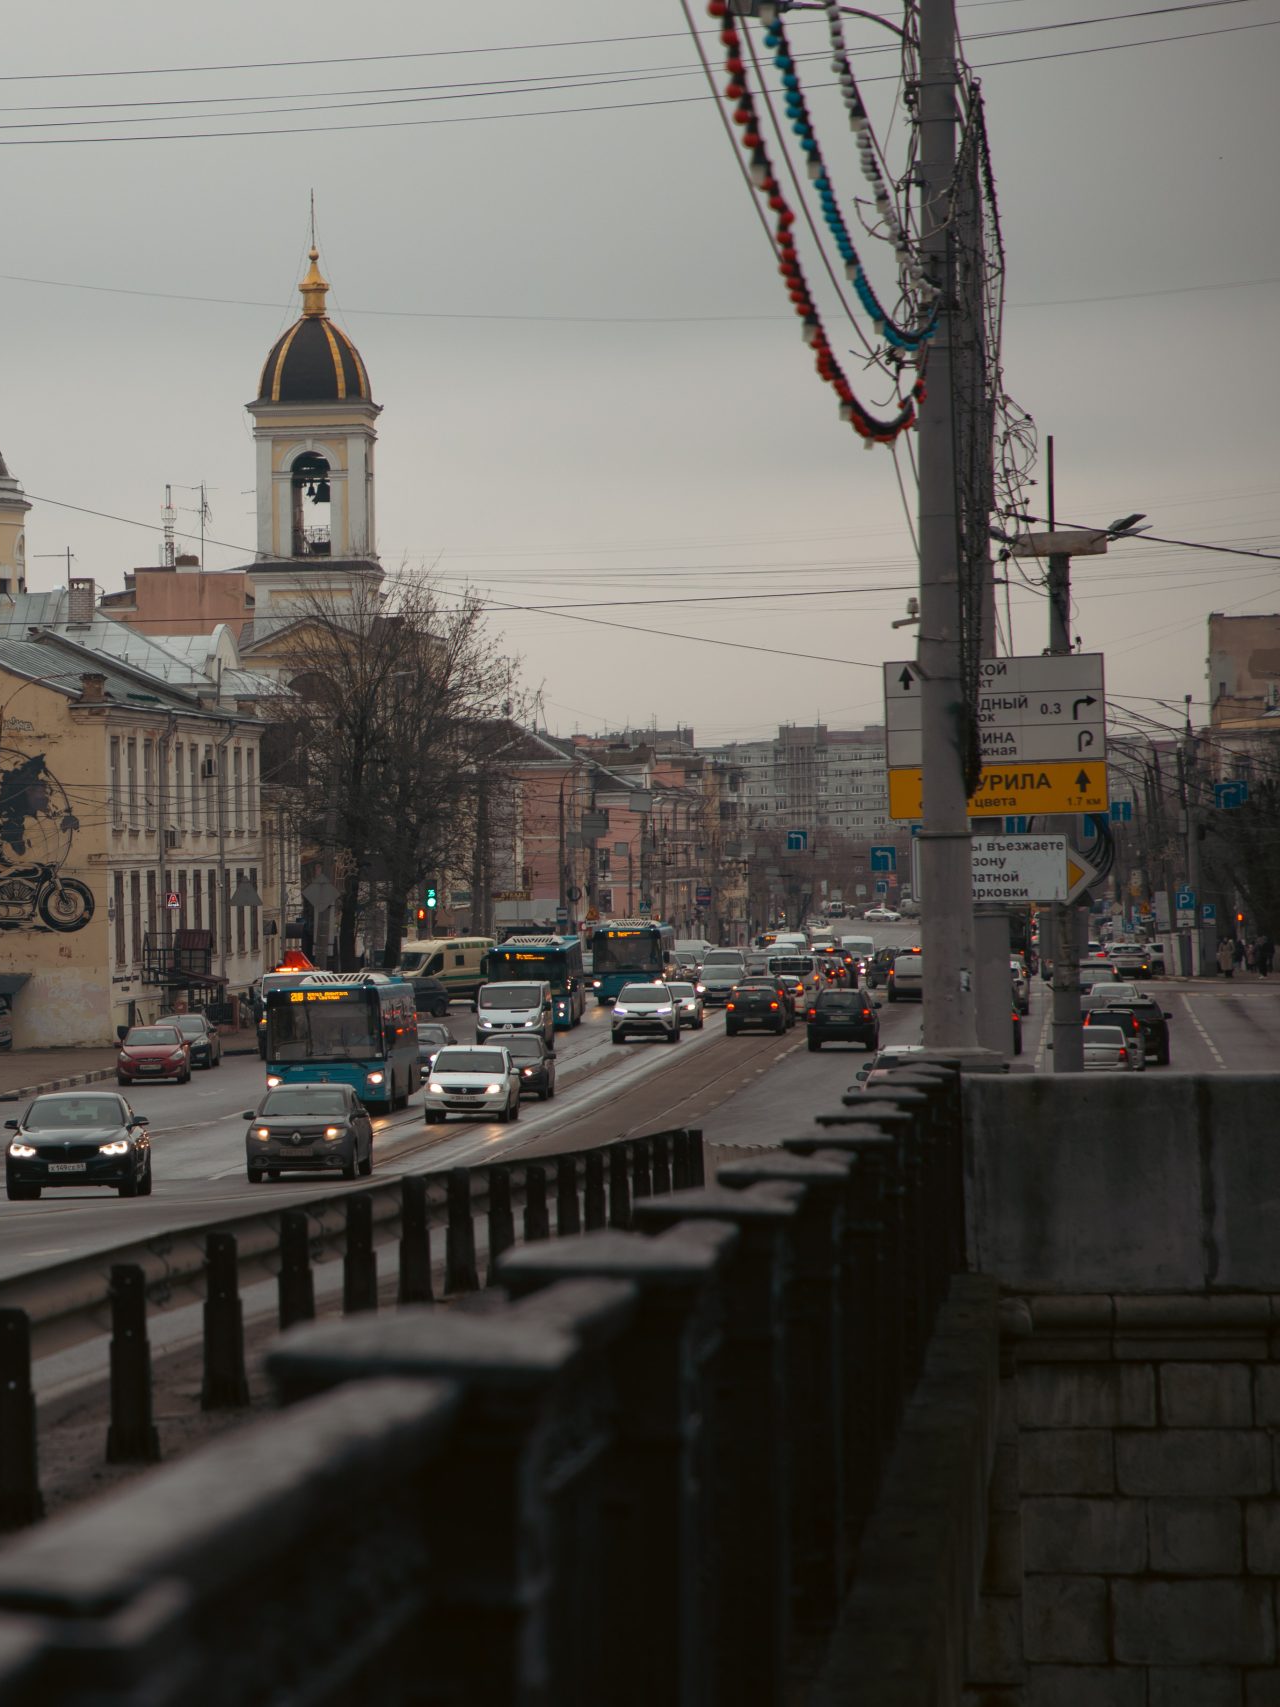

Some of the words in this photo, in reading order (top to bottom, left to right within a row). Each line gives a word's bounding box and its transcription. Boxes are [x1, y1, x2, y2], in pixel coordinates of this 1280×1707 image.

[978, 695, 1028, 711] ДНЫЙ
[1040, 703, 1062, 715] 0.3
[981, 732, 1015, 744] ИНА
[976, 773, 1052, 791] УРИЛА
[974, 797, 1017, 808] цвета
[986, 841, 1064, 851] въезжаете
[972, 858, 1007, 869] зону
